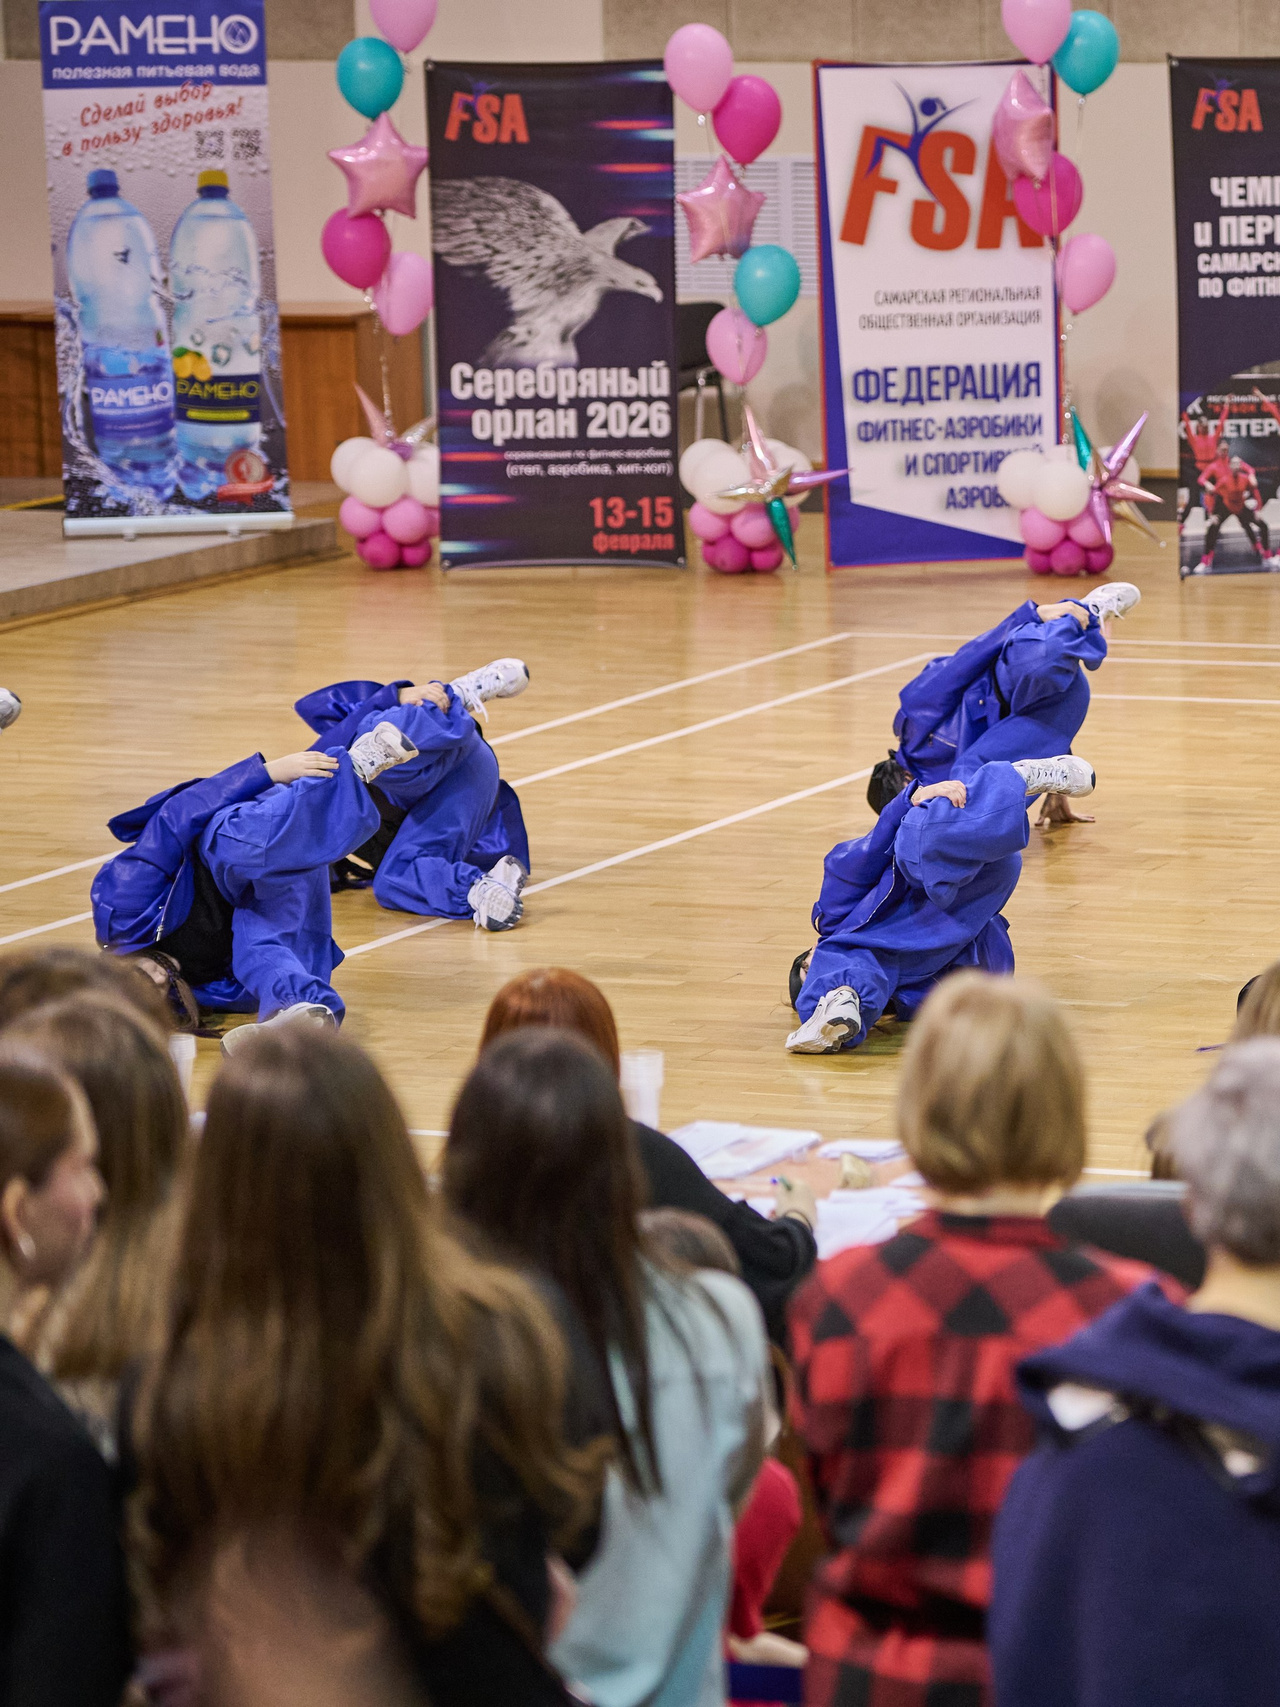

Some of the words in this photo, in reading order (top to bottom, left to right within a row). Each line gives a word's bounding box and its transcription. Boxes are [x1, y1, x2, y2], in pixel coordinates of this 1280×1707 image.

[50, 15, 258, 55] РАМЕНО
[52, 65, 132, 80] полезная
[137, 64, 215, 78] питьевая
[219, 63, 261, 78] вода
[80, 93, 145, 127] Сделай
[154, 80, 213, 108] выбор
[444, 91, 529, 143] FSA
[1191, 87, 1264, 133] FSA
[62, 141, 73, 157] в
[81, 126, 143, 151] пользу
[151, 96, 244, 135] здоровья!
[839, 124, 1044, 250] FSA
[874, 289, 946, 306] САМАРСКАЯ
[949, 285, 1042, 304] РЕГИОНАЛЬНАЯ
[1198, 277, 1224, 298] ПО
[858, 312, 953, 331] ОБЩЕСТВЕННАЯ
[956, 309, 1042, 327] ОРГАНИЗАЦИЯ
[450, 360, 671, 406] Серебряный
[853, 361, 1042, 406] ФЕДЕРАЦИЯ
[471, 407, 578, 446] орлан
[586, 401, 671, 438] 2026
[857, 414, 1043, 443] ФИТНЕС-АЭРОБИКИ
[904, 454, 918, 476] И
[589, 496, 674, 528] 13-15
[592, 532, 675, 554] февраля
